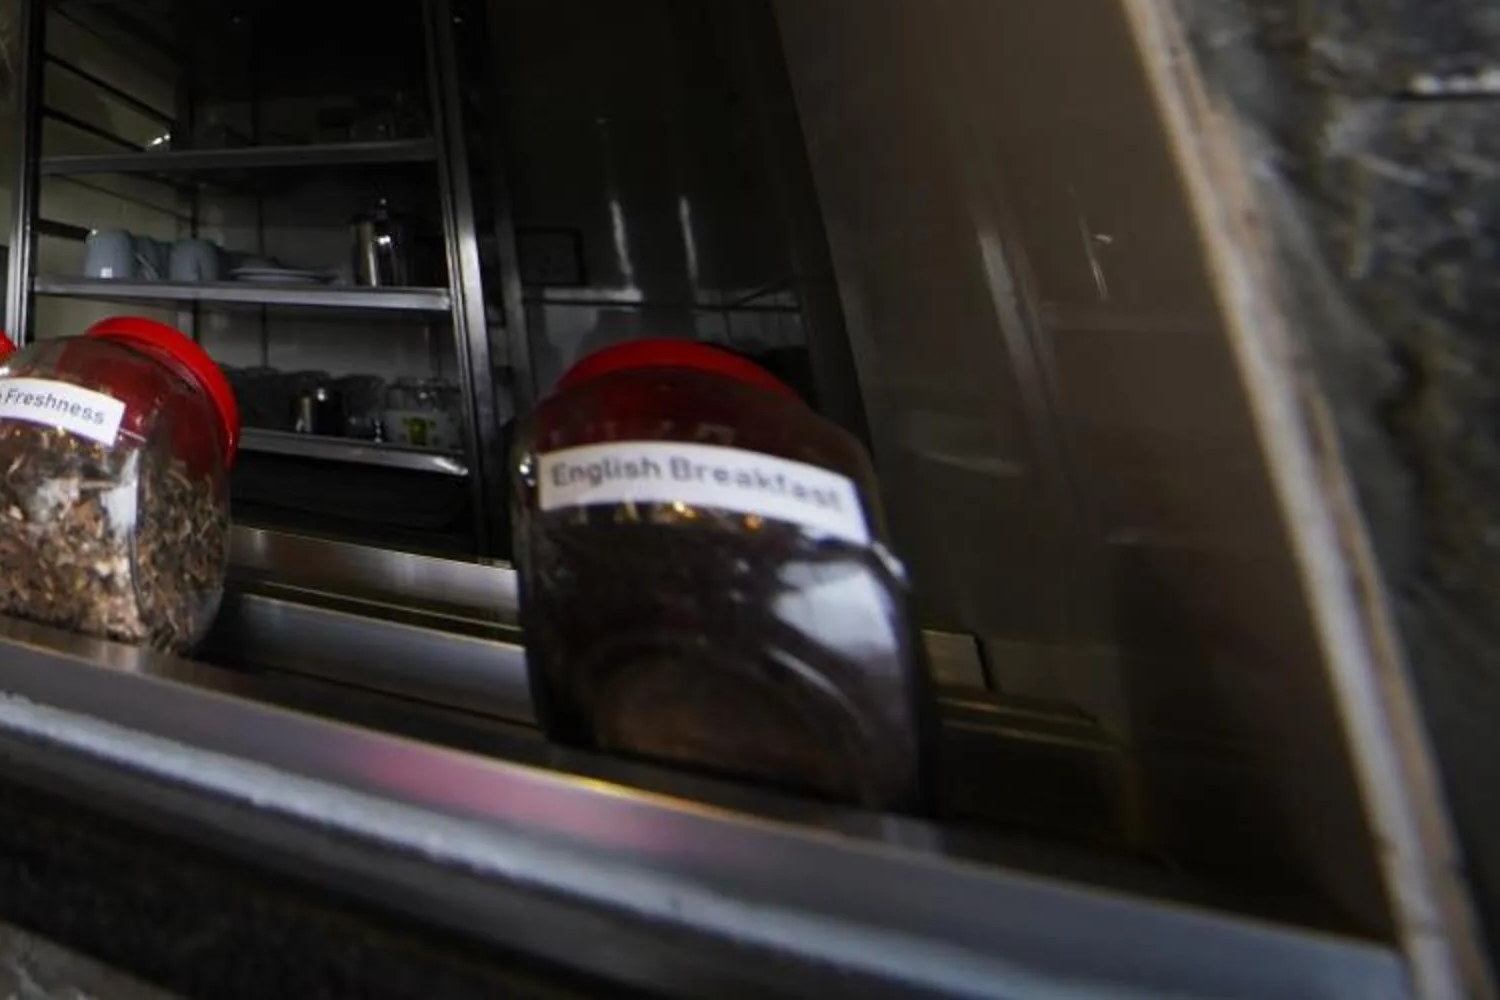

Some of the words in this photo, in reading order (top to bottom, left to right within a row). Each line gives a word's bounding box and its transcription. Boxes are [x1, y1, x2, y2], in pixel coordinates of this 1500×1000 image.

[4, 387, 105, 425] Freshness
[550, 455, 662, 488] English
[670, 456, 842, 511] Breakfast
